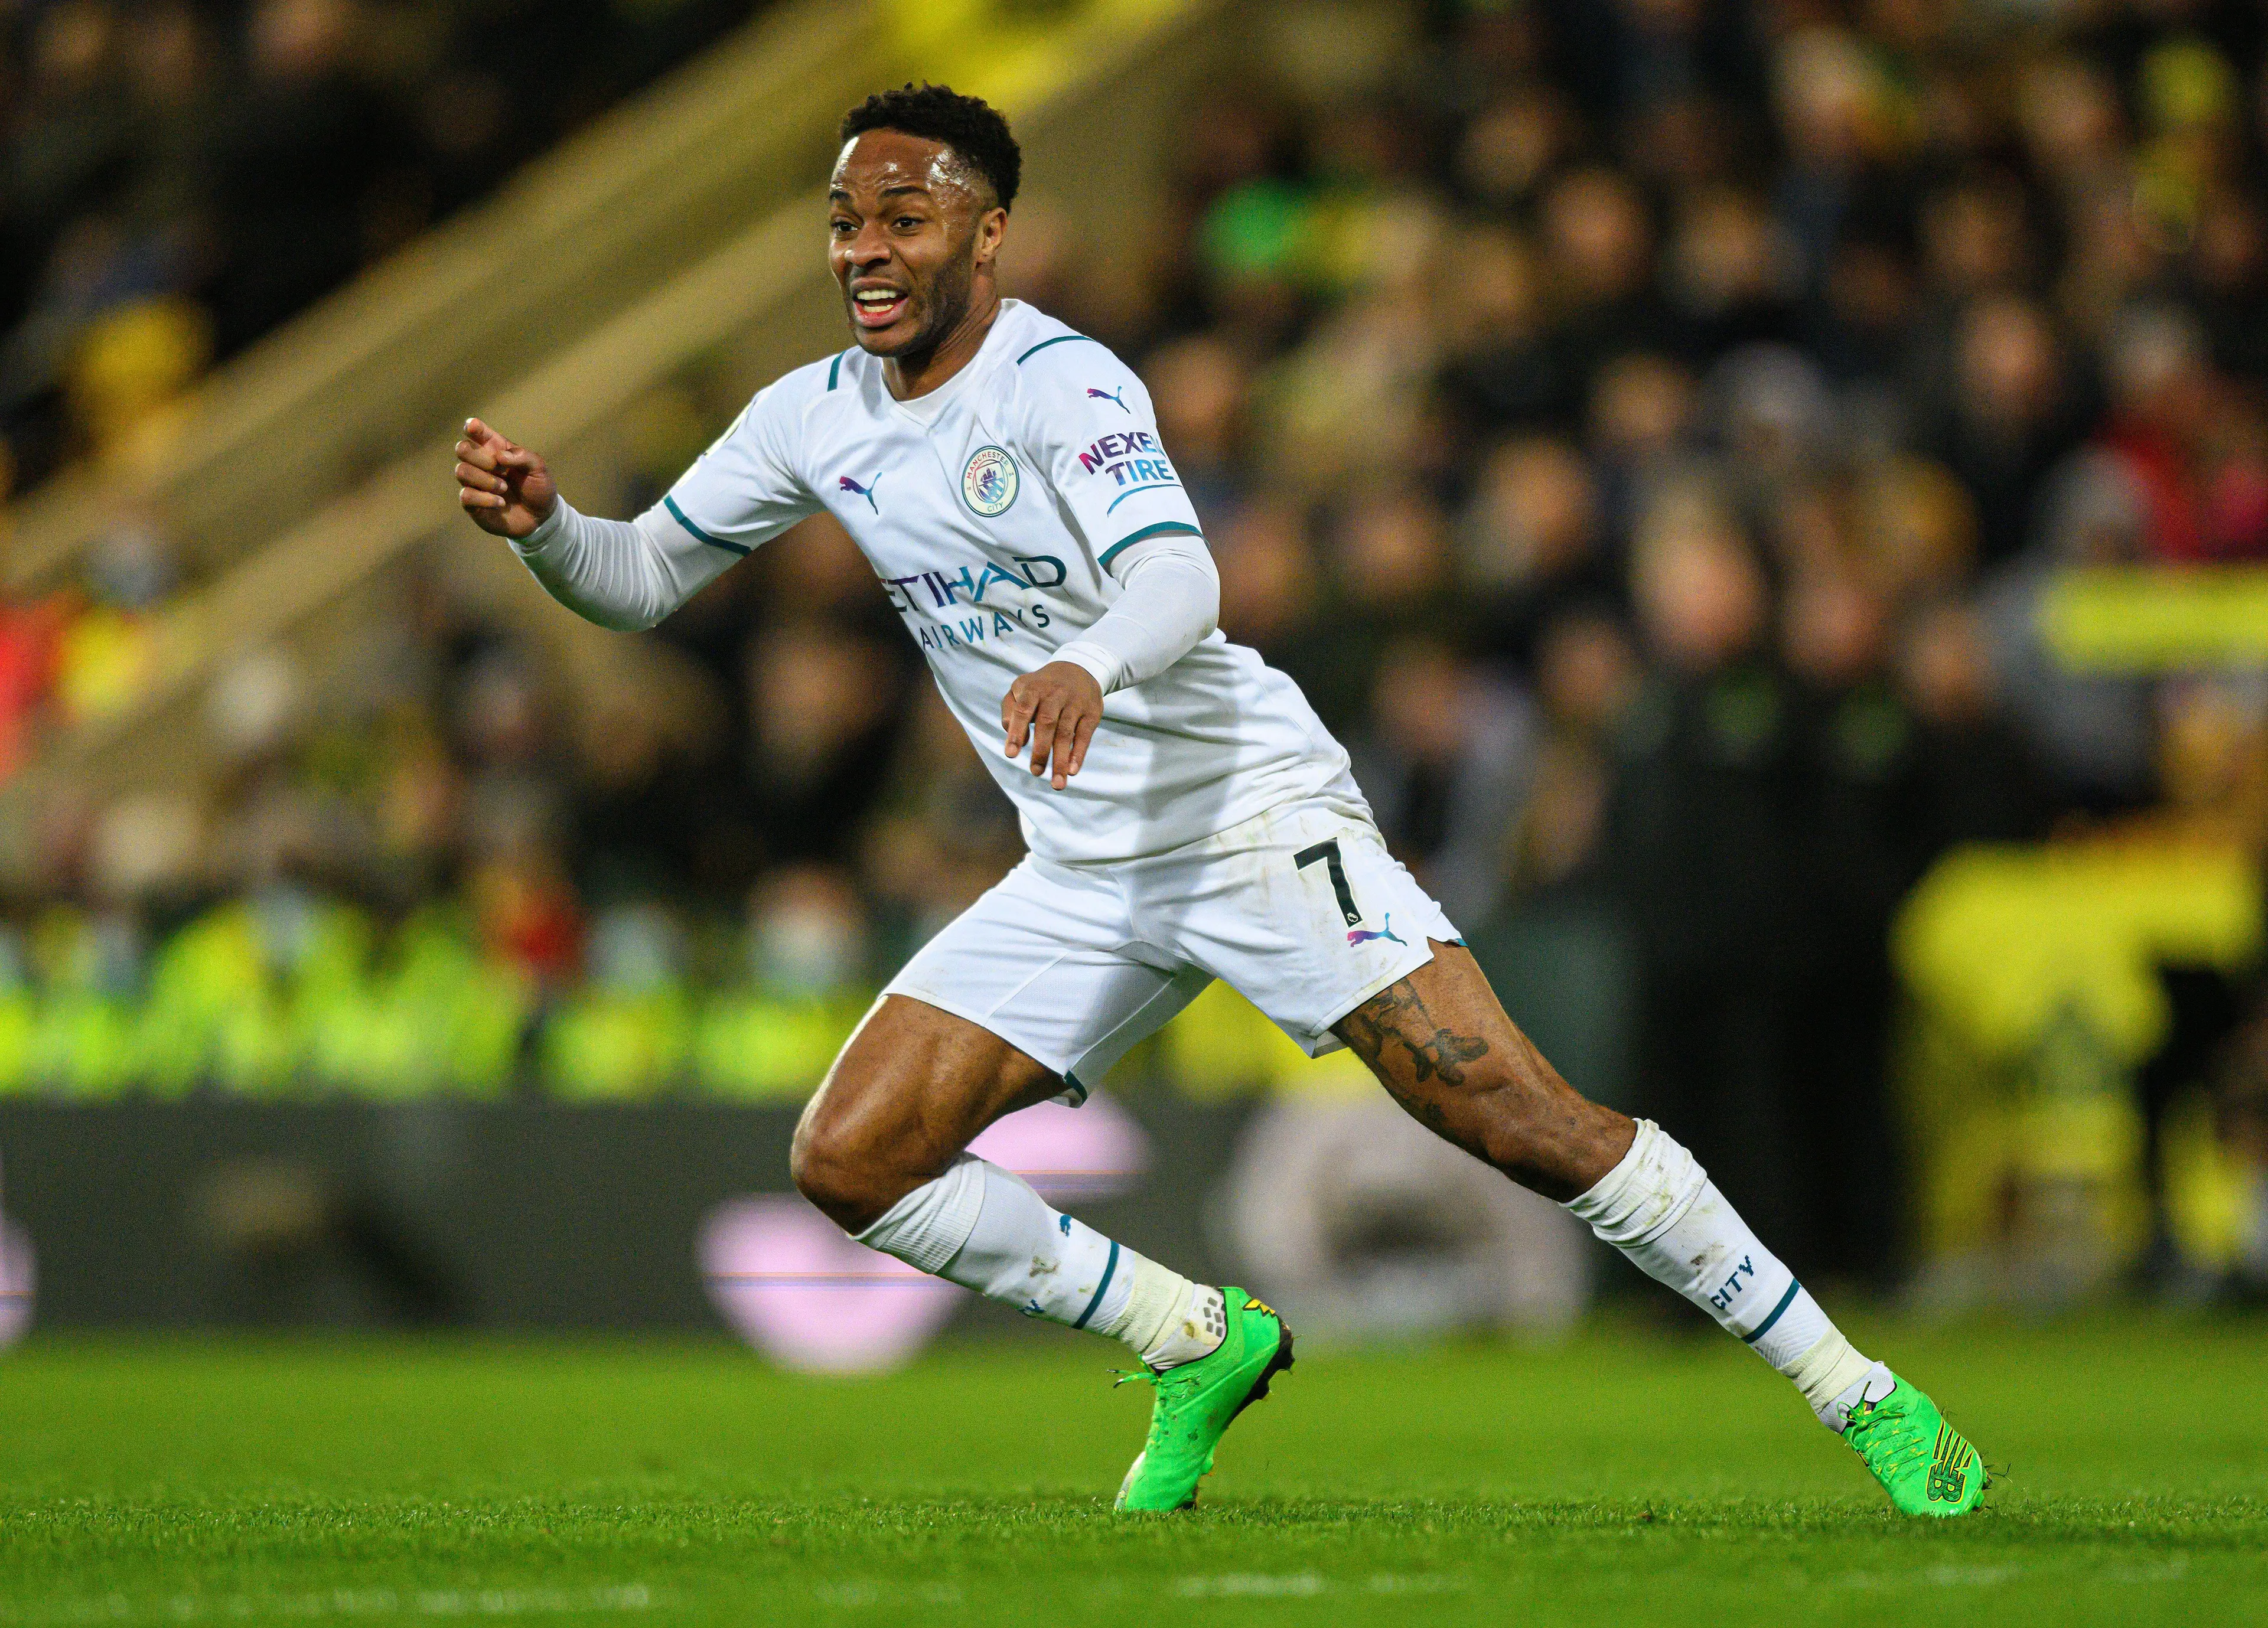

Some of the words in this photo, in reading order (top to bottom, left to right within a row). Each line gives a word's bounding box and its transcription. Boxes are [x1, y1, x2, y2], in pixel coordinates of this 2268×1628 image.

[966, 451, 1009, 479] MANCHESTER
[1105, 459, 1174, 486] TIRE
[988, 501, 1003, 512] CITY
[920, 604, 1051, 649] AIRWAYS
[1293, 836, 1363, 928] 7
[1710, 1255, 1754, 1310] CITY
